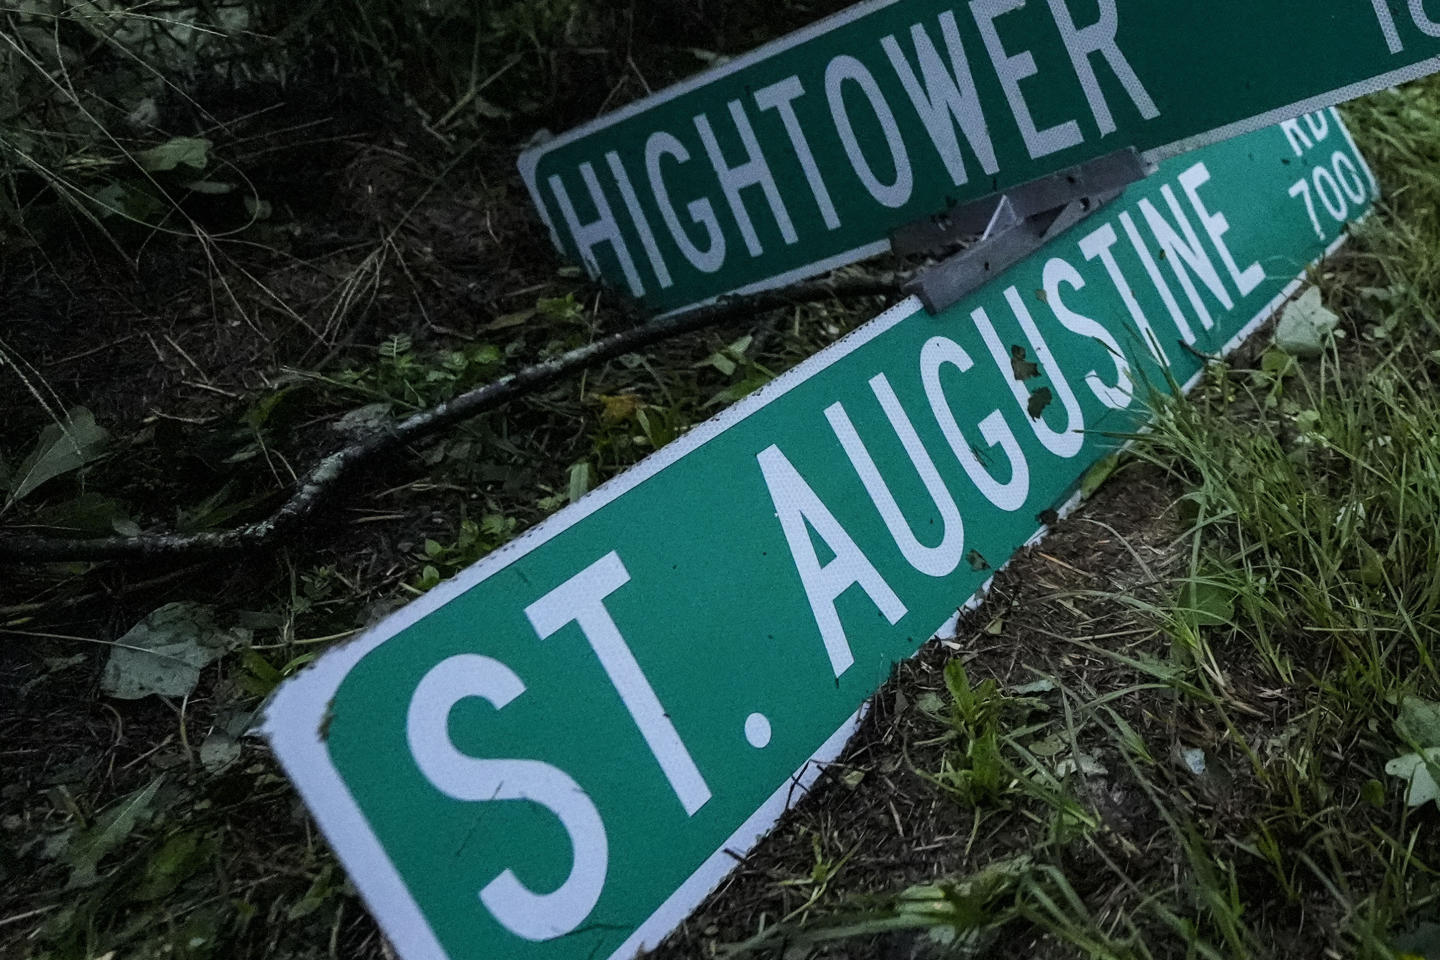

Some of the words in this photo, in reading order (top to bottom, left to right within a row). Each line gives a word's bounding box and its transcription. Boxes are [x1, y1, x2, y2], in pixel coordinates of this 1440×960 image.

[1288, 150, 1366, 241] 700
[406, 549, 772, 942] ST.
[755, 161, 1267, 679] AUGUSTINE
